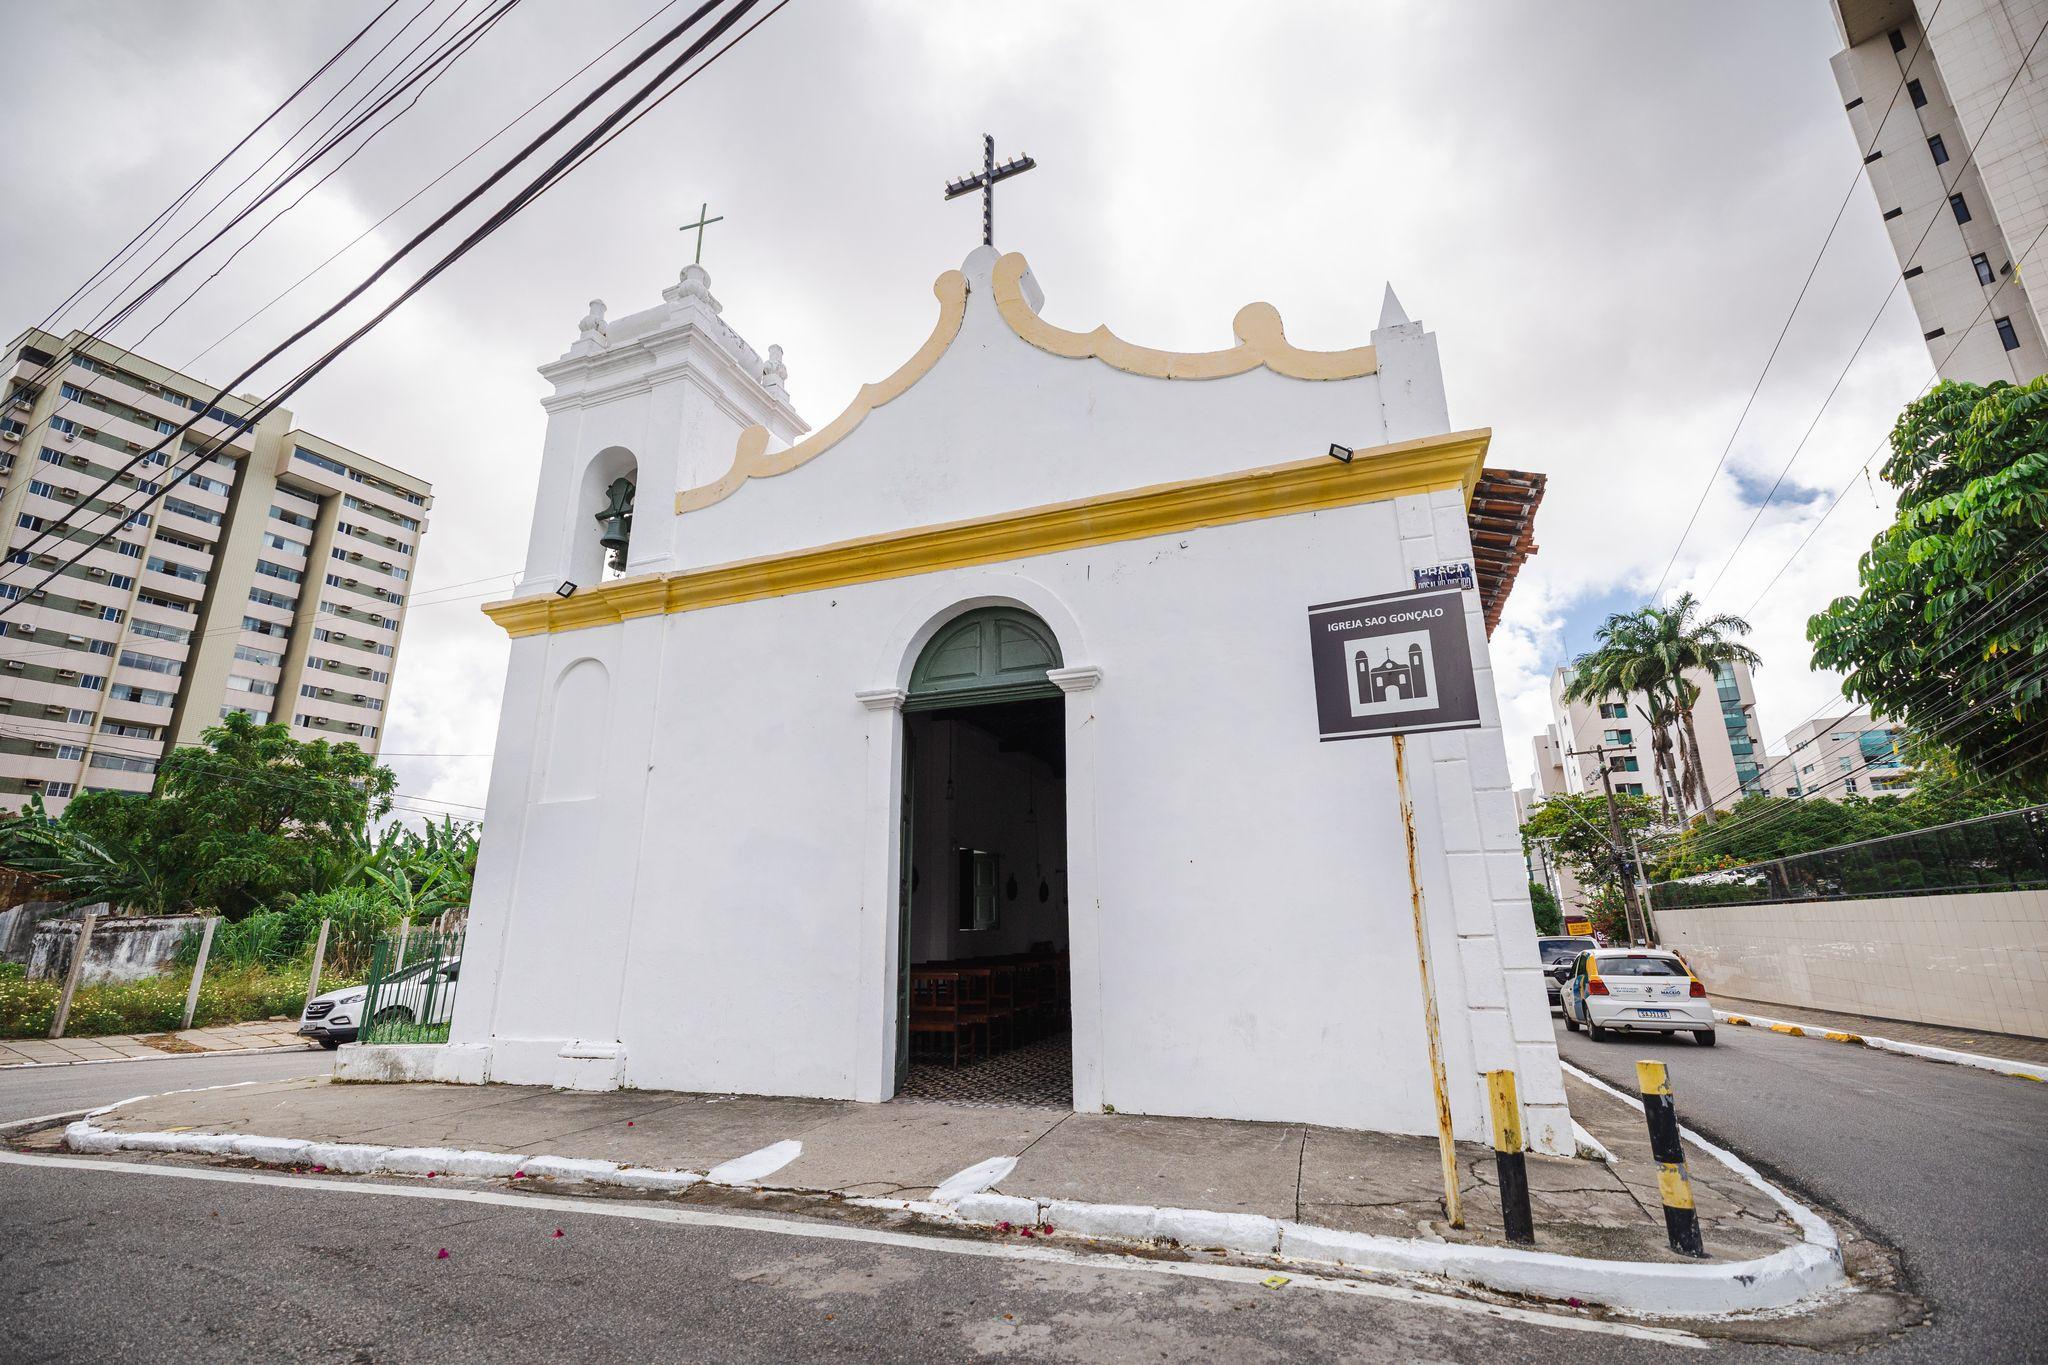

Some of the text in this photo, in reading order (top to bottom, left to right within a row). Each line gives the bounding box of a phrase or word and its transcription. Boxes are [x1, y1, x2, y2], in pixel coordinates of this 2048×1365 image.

[1327, 608, 1444, 632] IGREJA SAO GONÇALO
